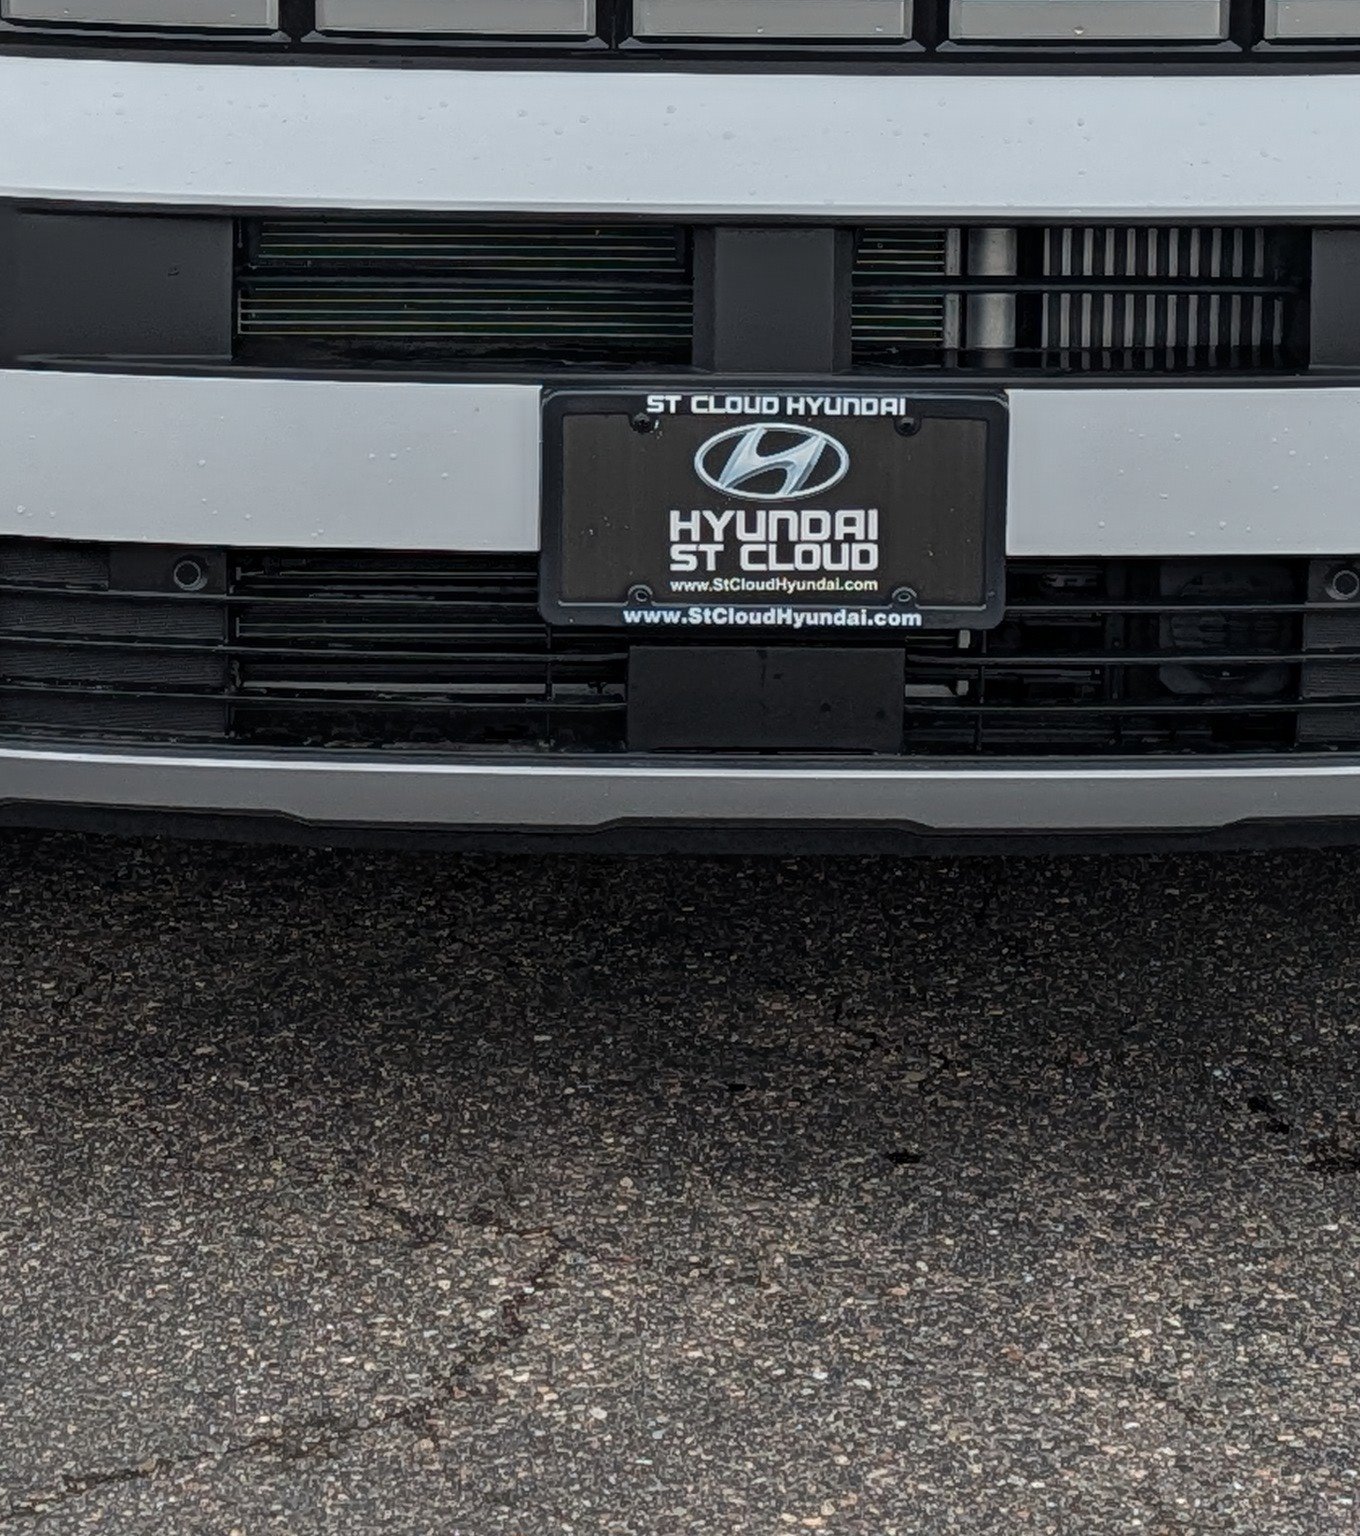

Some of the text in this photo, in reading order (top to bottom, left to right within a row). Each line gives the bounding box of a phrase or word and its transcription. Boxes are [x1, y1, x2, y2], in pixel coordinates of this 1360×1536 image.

[646, 394, 907, 416] ST CLOUD HYUNDAI
[669, 508, 879, 542] HYUNDAI
[669, 542, 879, 572] ST CLOUD
[669, 577, 879, 594] www.StCloudHyundai.com
[623, 606, 923, 629] www.StCloudHyundai.com
